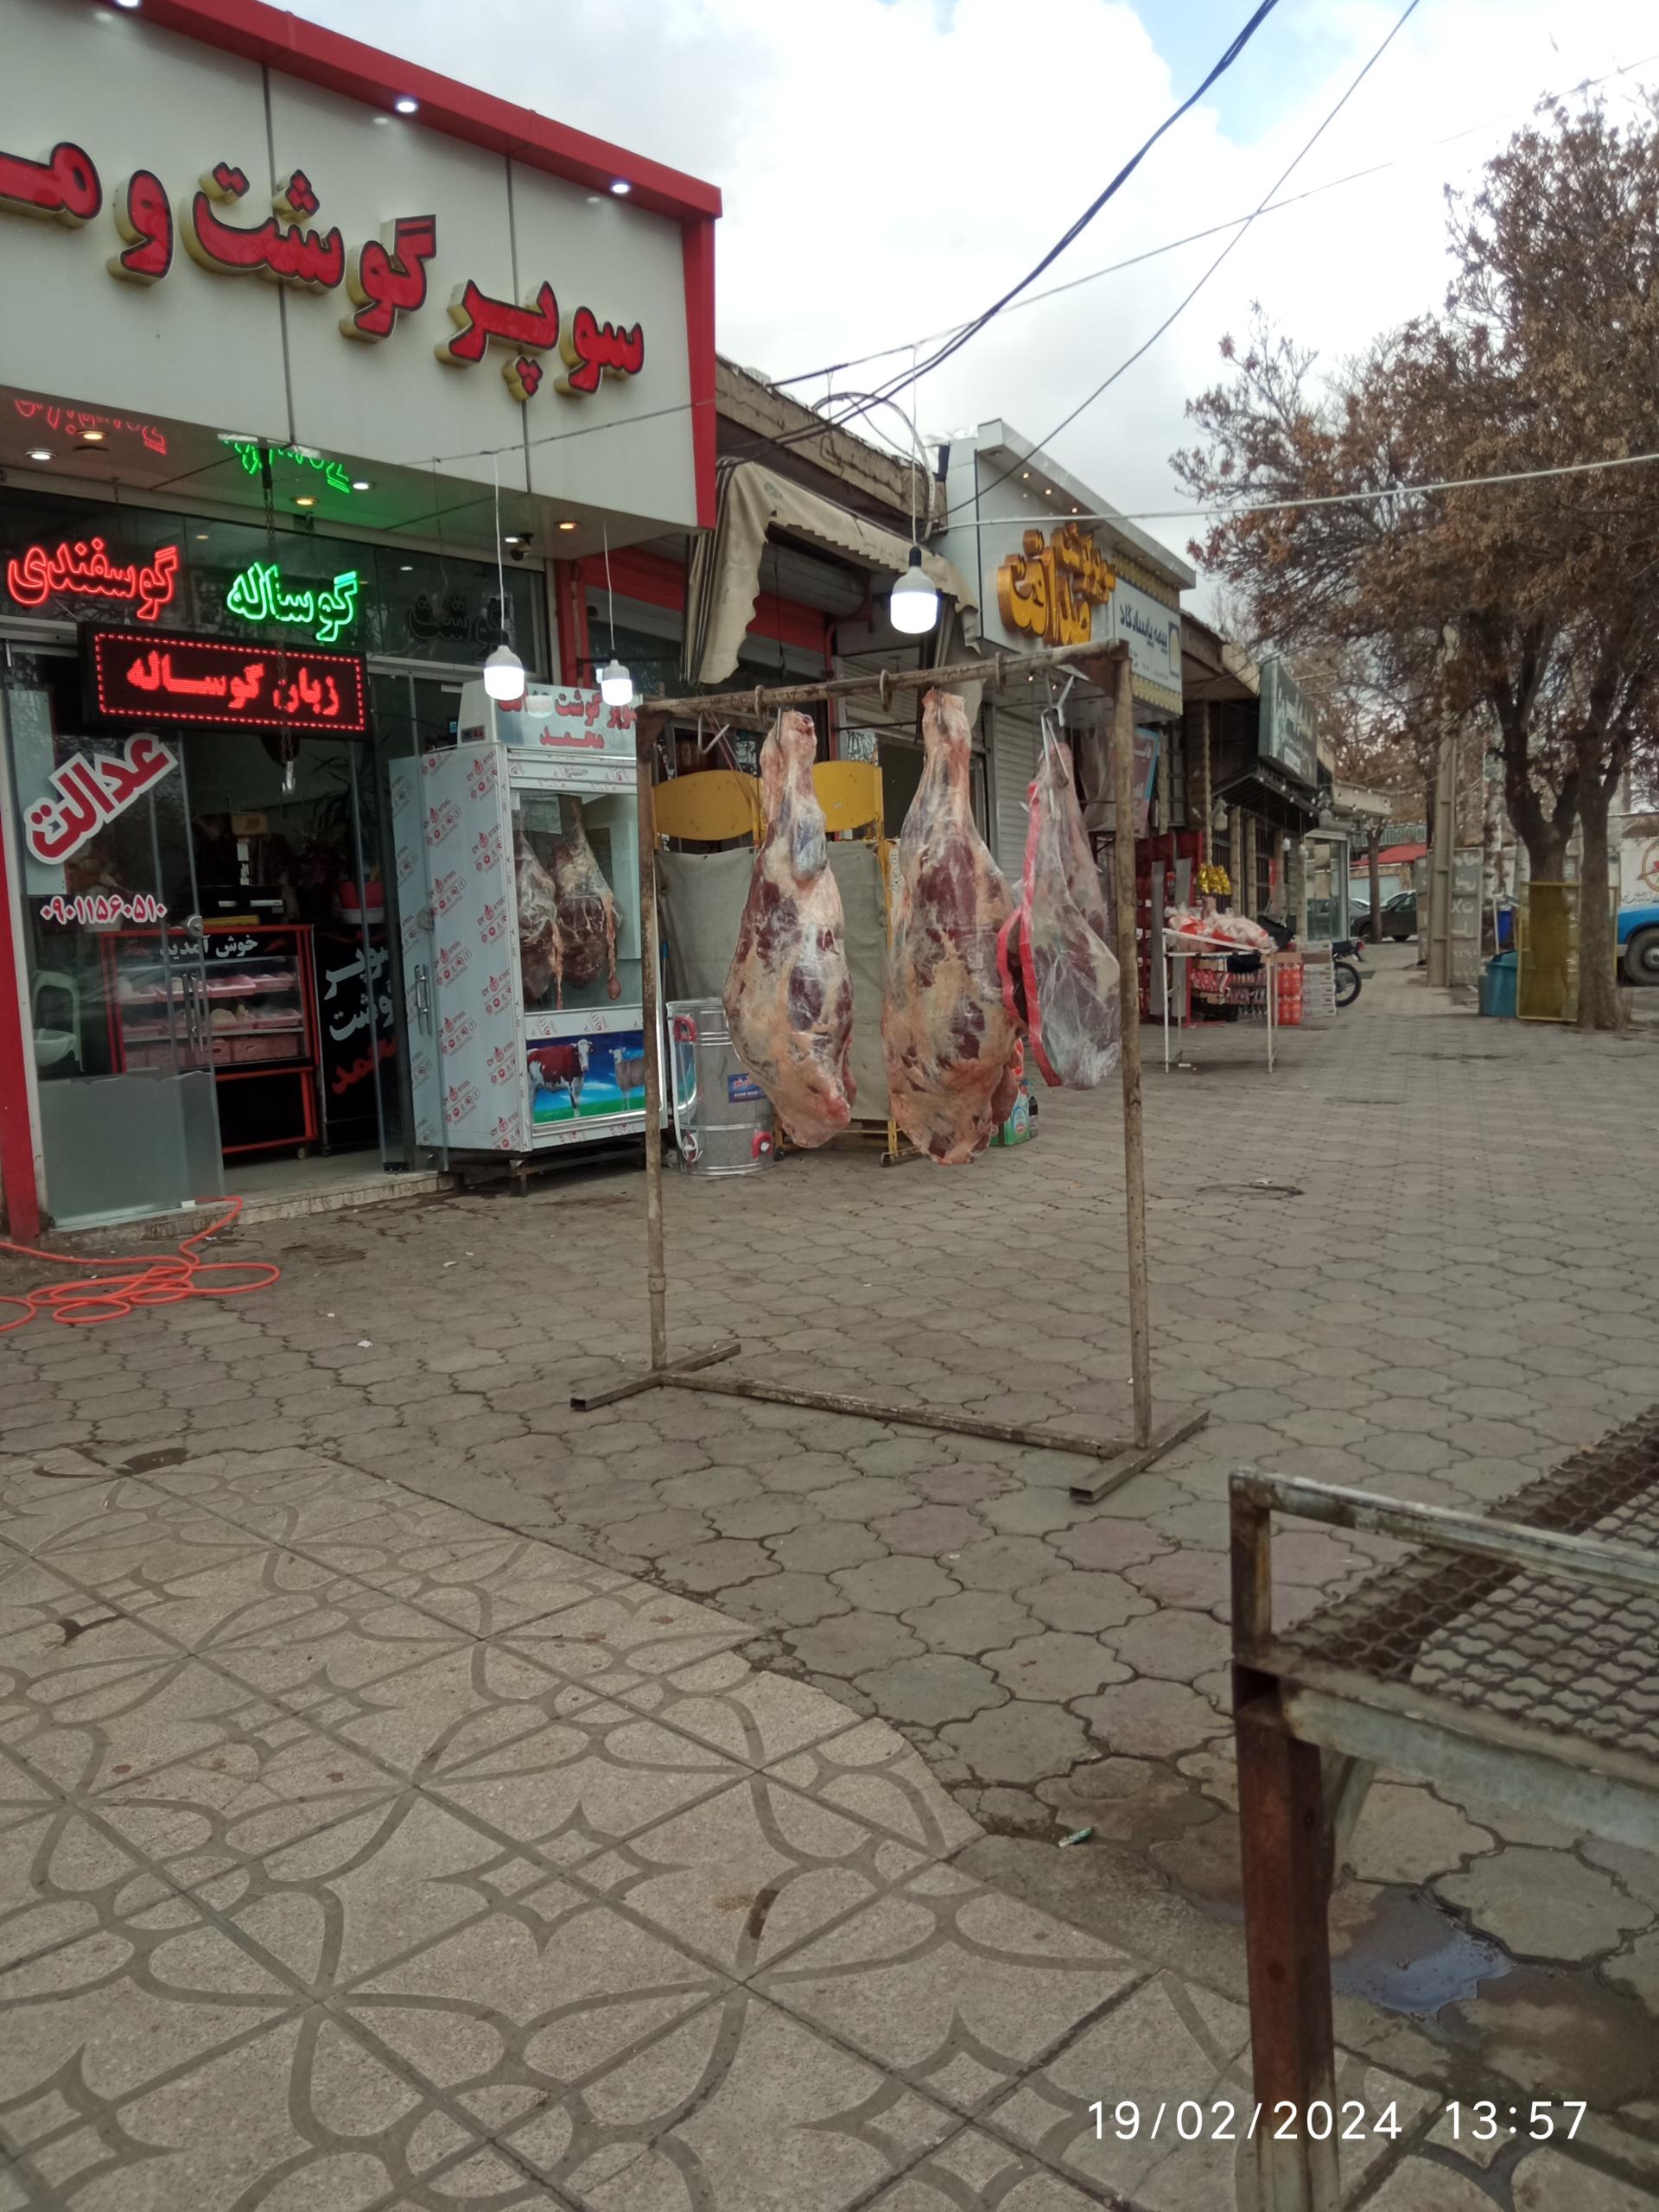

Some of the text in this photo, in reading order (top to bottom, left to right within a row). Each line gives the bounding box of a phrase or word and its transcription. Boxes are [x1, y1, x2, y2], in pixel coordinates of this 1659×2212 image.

[114, 169, 173, 284] و
[184, 161, 437, 341] گوشت
[442, 278, 645, 400] سوپر
[7, 536, 179, 621] گوسفندی
[226, 562, 359, 642] گوساله
[998, 528, 1092, 647] صداقت
[126, 650, 340, 716] زبان گوساله
[555, 690, 602, 727] گوشت
[26, 734, 176, 863] عدالت
[40, 893, 168, 925] ۰۹۰۱۱۵۶۰۵۱۰
[216, 934, 258, 957] خوش
